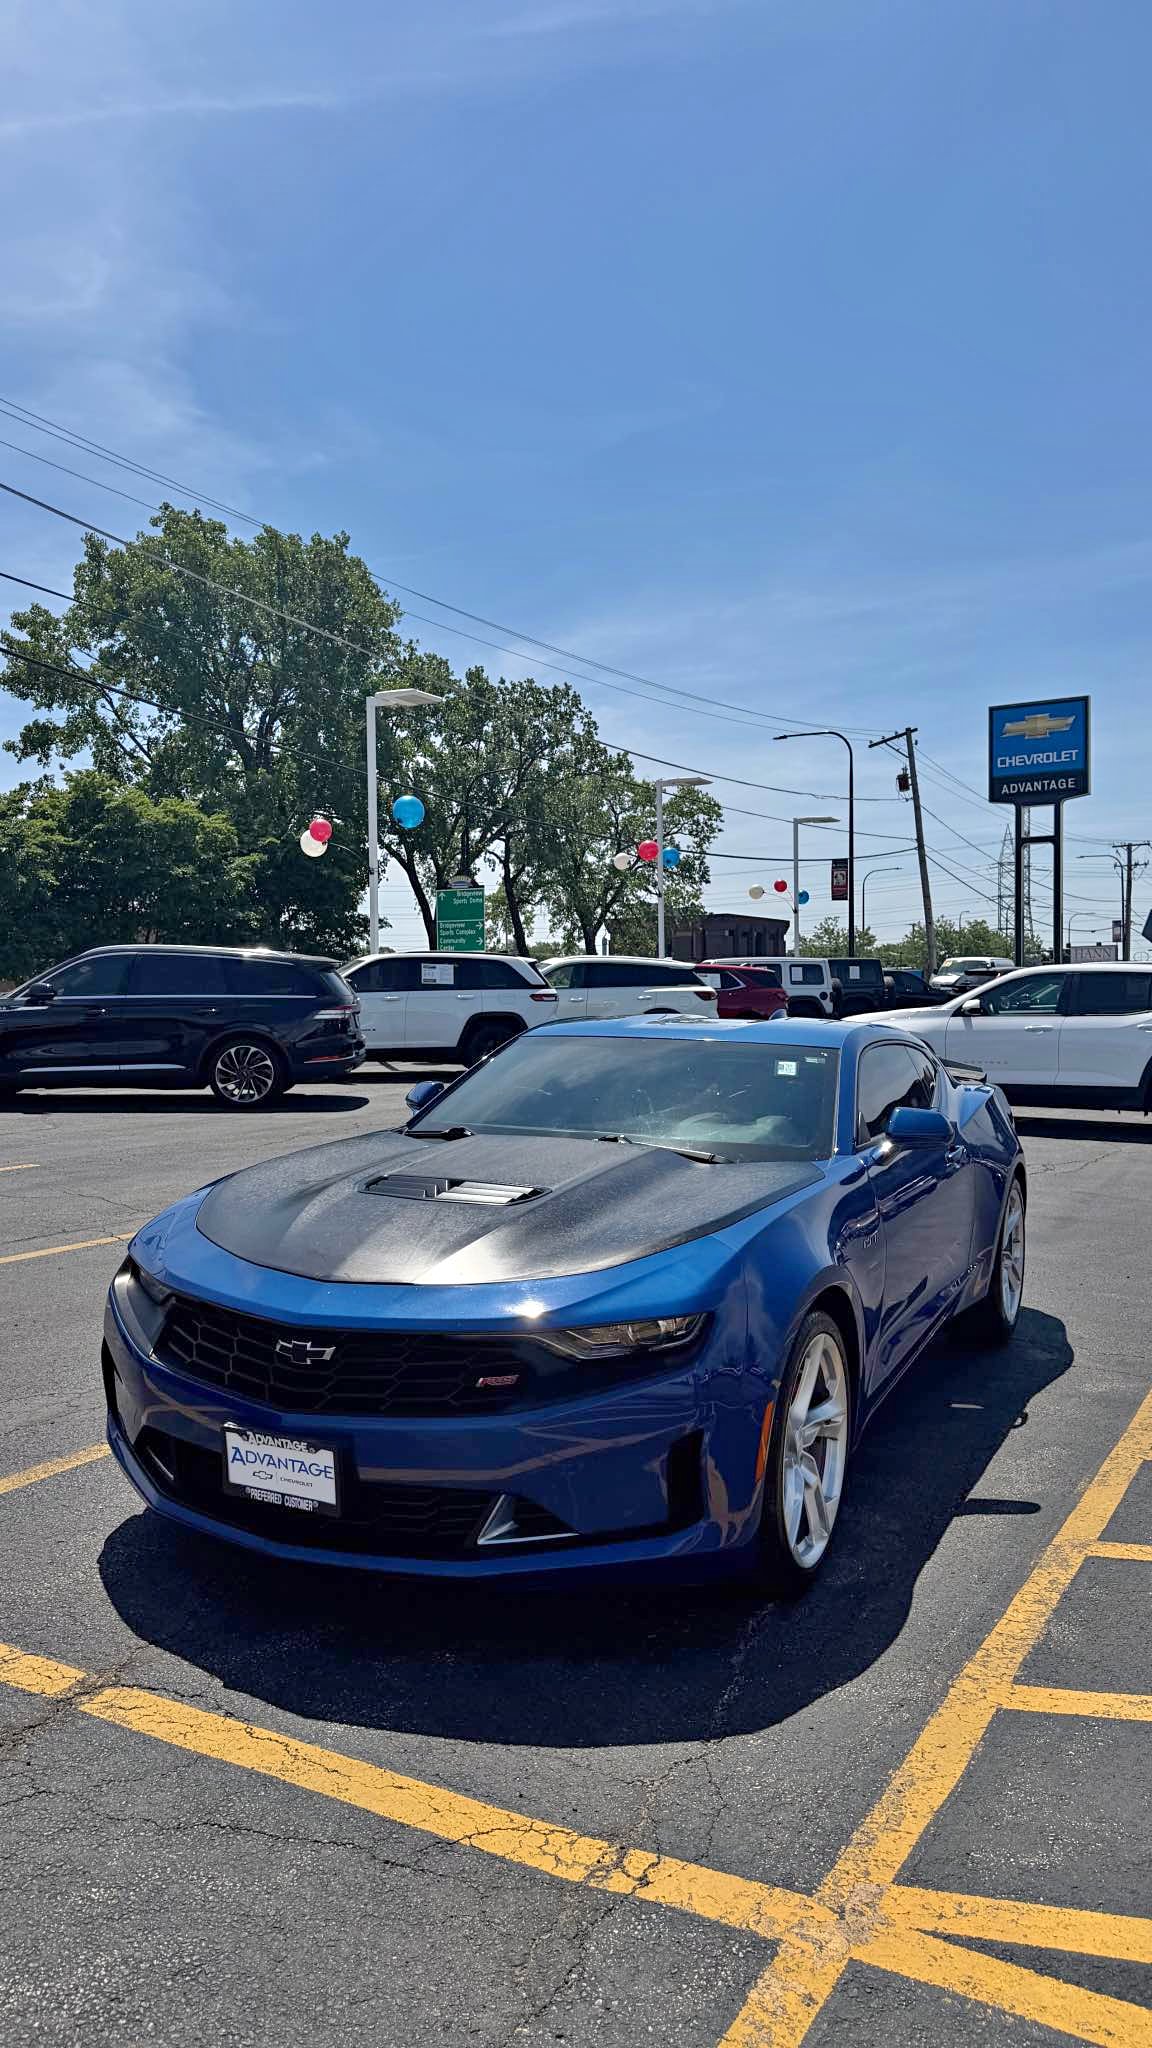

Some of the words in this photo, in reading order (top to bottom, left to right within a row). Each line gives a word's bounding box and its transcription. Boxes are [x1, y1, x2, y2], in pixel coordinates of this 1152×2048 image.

[997, 749, 1080, 769] CHEVROLET
[1001, 777, 1076, 795] ADVANTAGE
[453, 898, 468, 906] Sports
[455, 929, 476, 937] Complex
[478, 1375, 517, 1387] RS
[246, 1431, 309, 1453] ADVANTAGE
[230, 1447, 334, 1479] ADVANTAGE
[280, 1477, 313, 1487] CHEVROLET
[250, 1488, 282, 1504] PREFERRED
[284, 1496, 313, 1511] CUSTOMER
